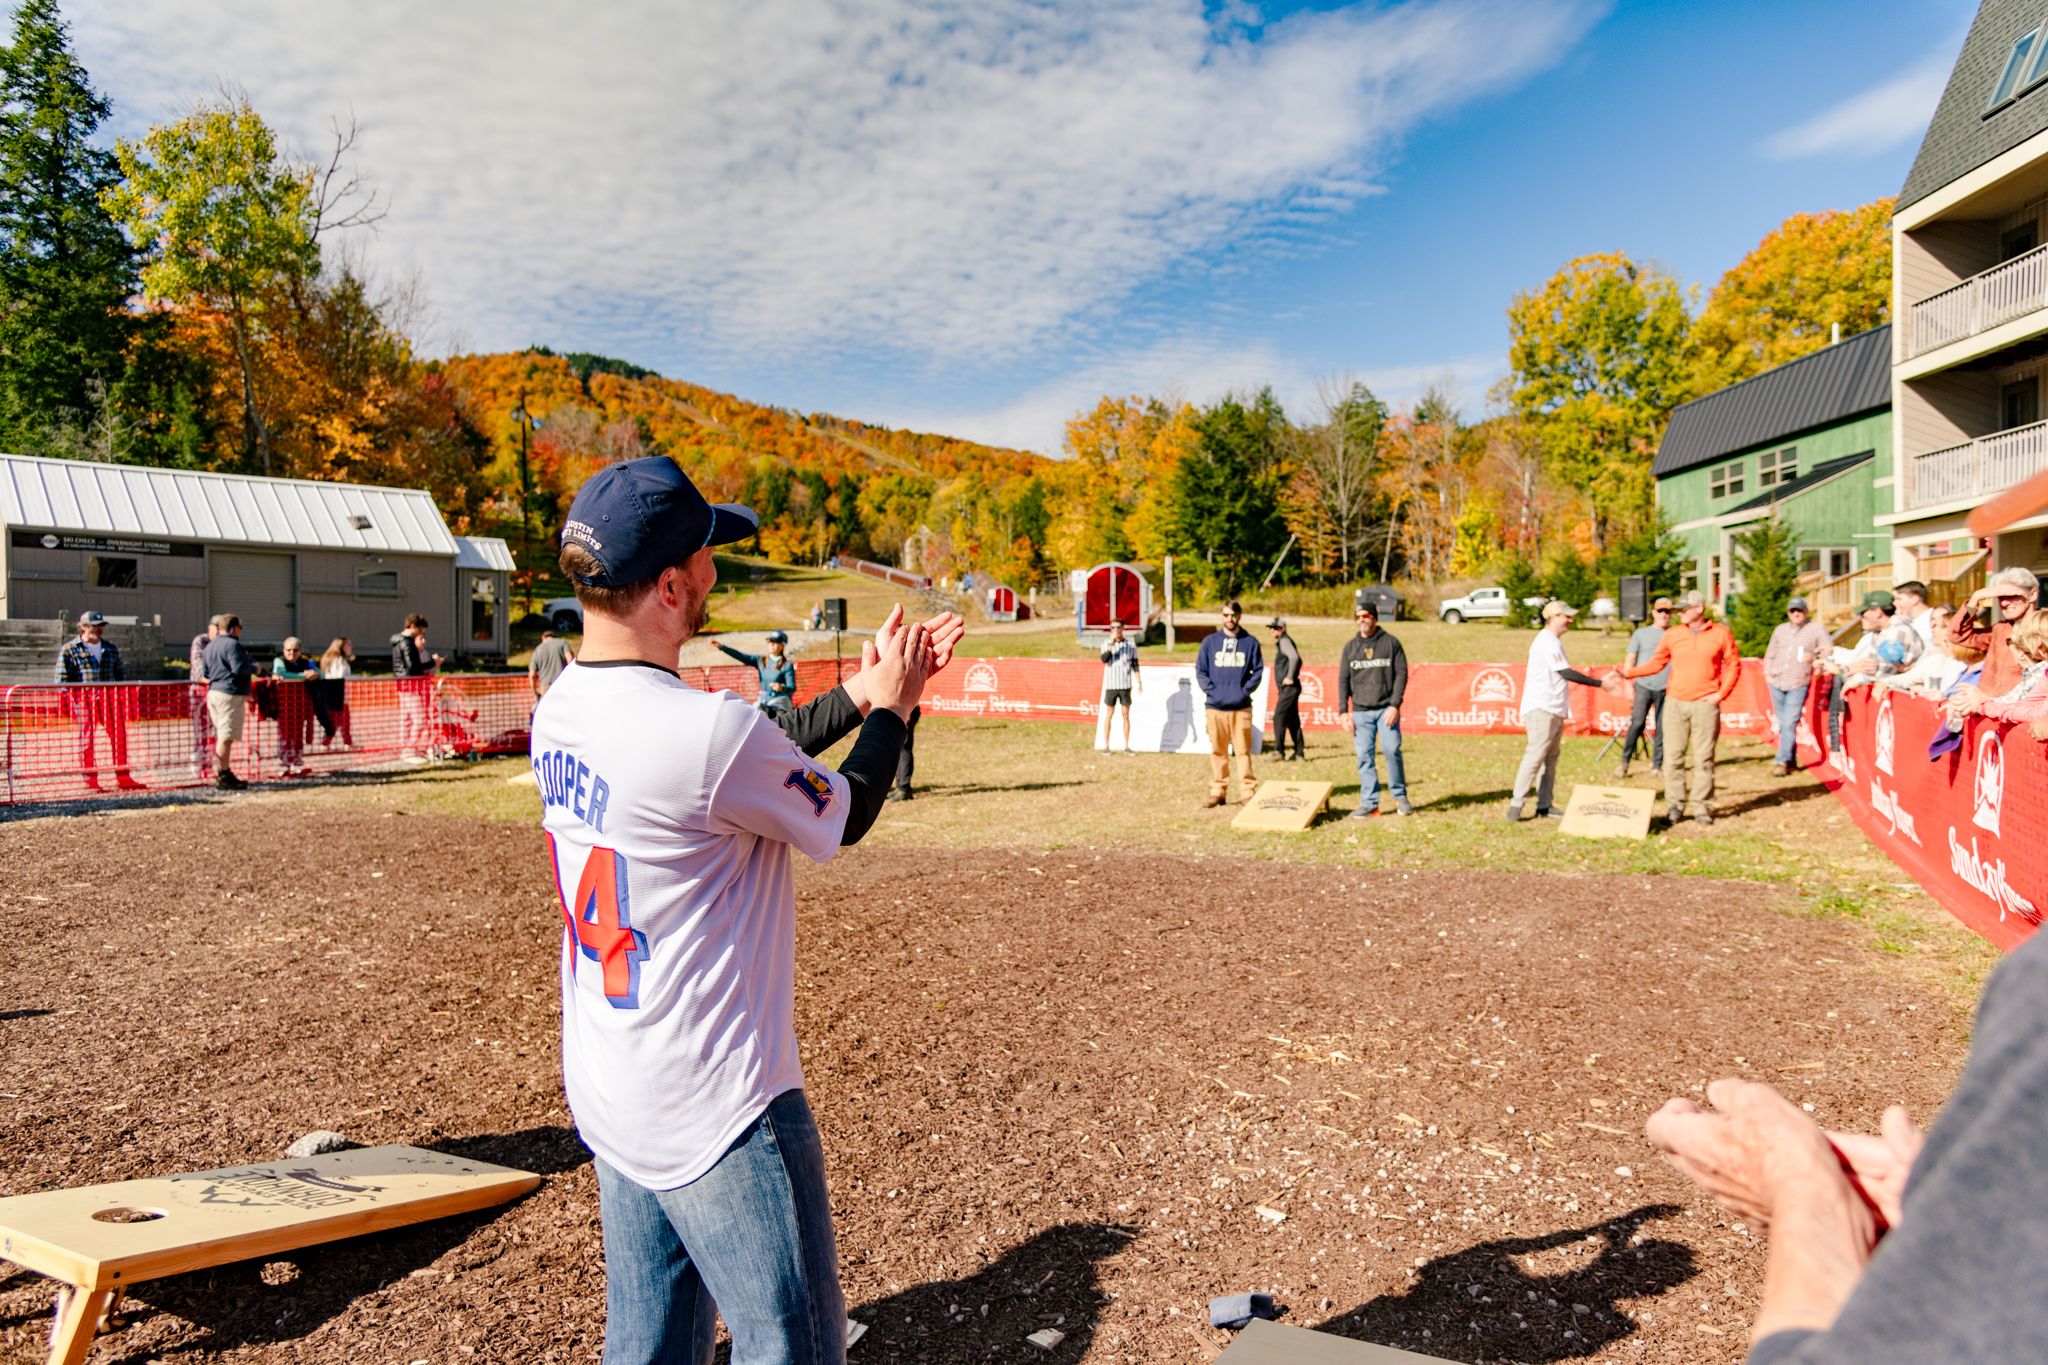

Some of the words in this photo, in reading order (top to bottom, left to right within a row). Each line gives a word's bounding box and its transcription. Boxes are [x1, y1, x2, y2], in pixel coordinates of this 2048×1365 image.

[932, 695, 987, 715] Sunday
[989, 695, 1031, 712] River
[1426, 706, 1499, 729] Sunday
[534, 750, 610, 834] COOPER
[214, 1170, 357, 1207] CORNHOLE
